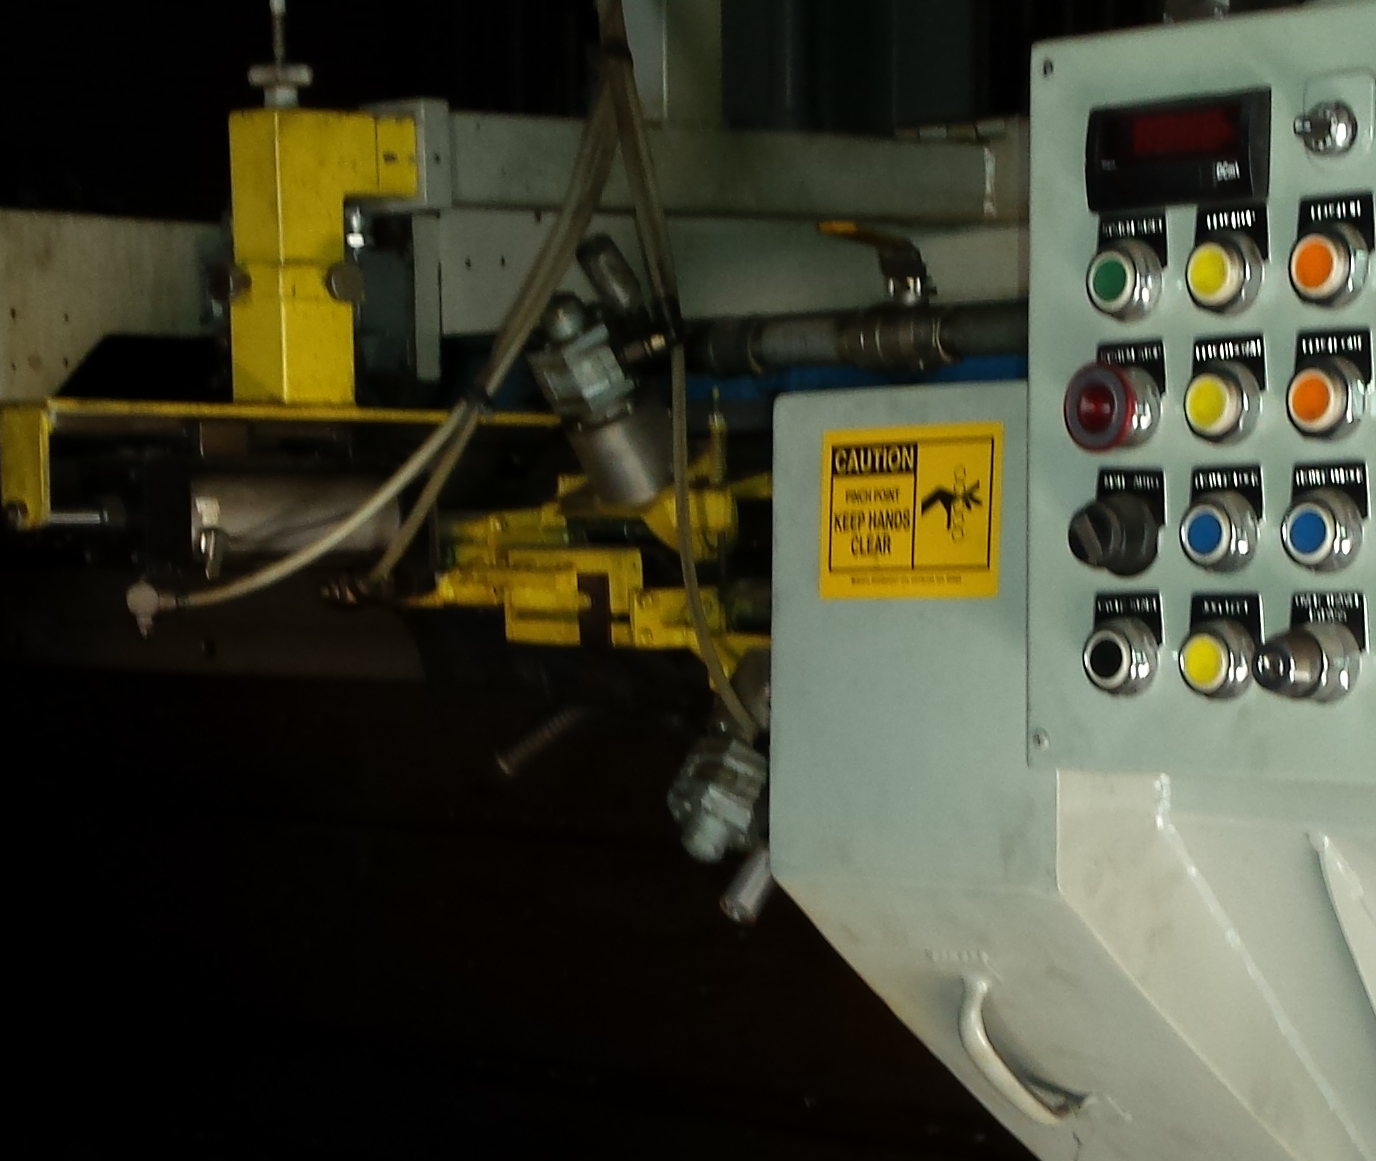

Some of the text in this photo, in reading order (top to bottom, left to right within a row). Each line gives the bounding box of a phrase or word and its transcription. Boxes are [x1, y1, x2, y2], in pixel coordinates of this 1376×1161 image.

[835, 446, 914, 475] CAUTION
[834, 508, 910, 533] KEEP HANDS
[851, 534, 891, 557] CLEAR
